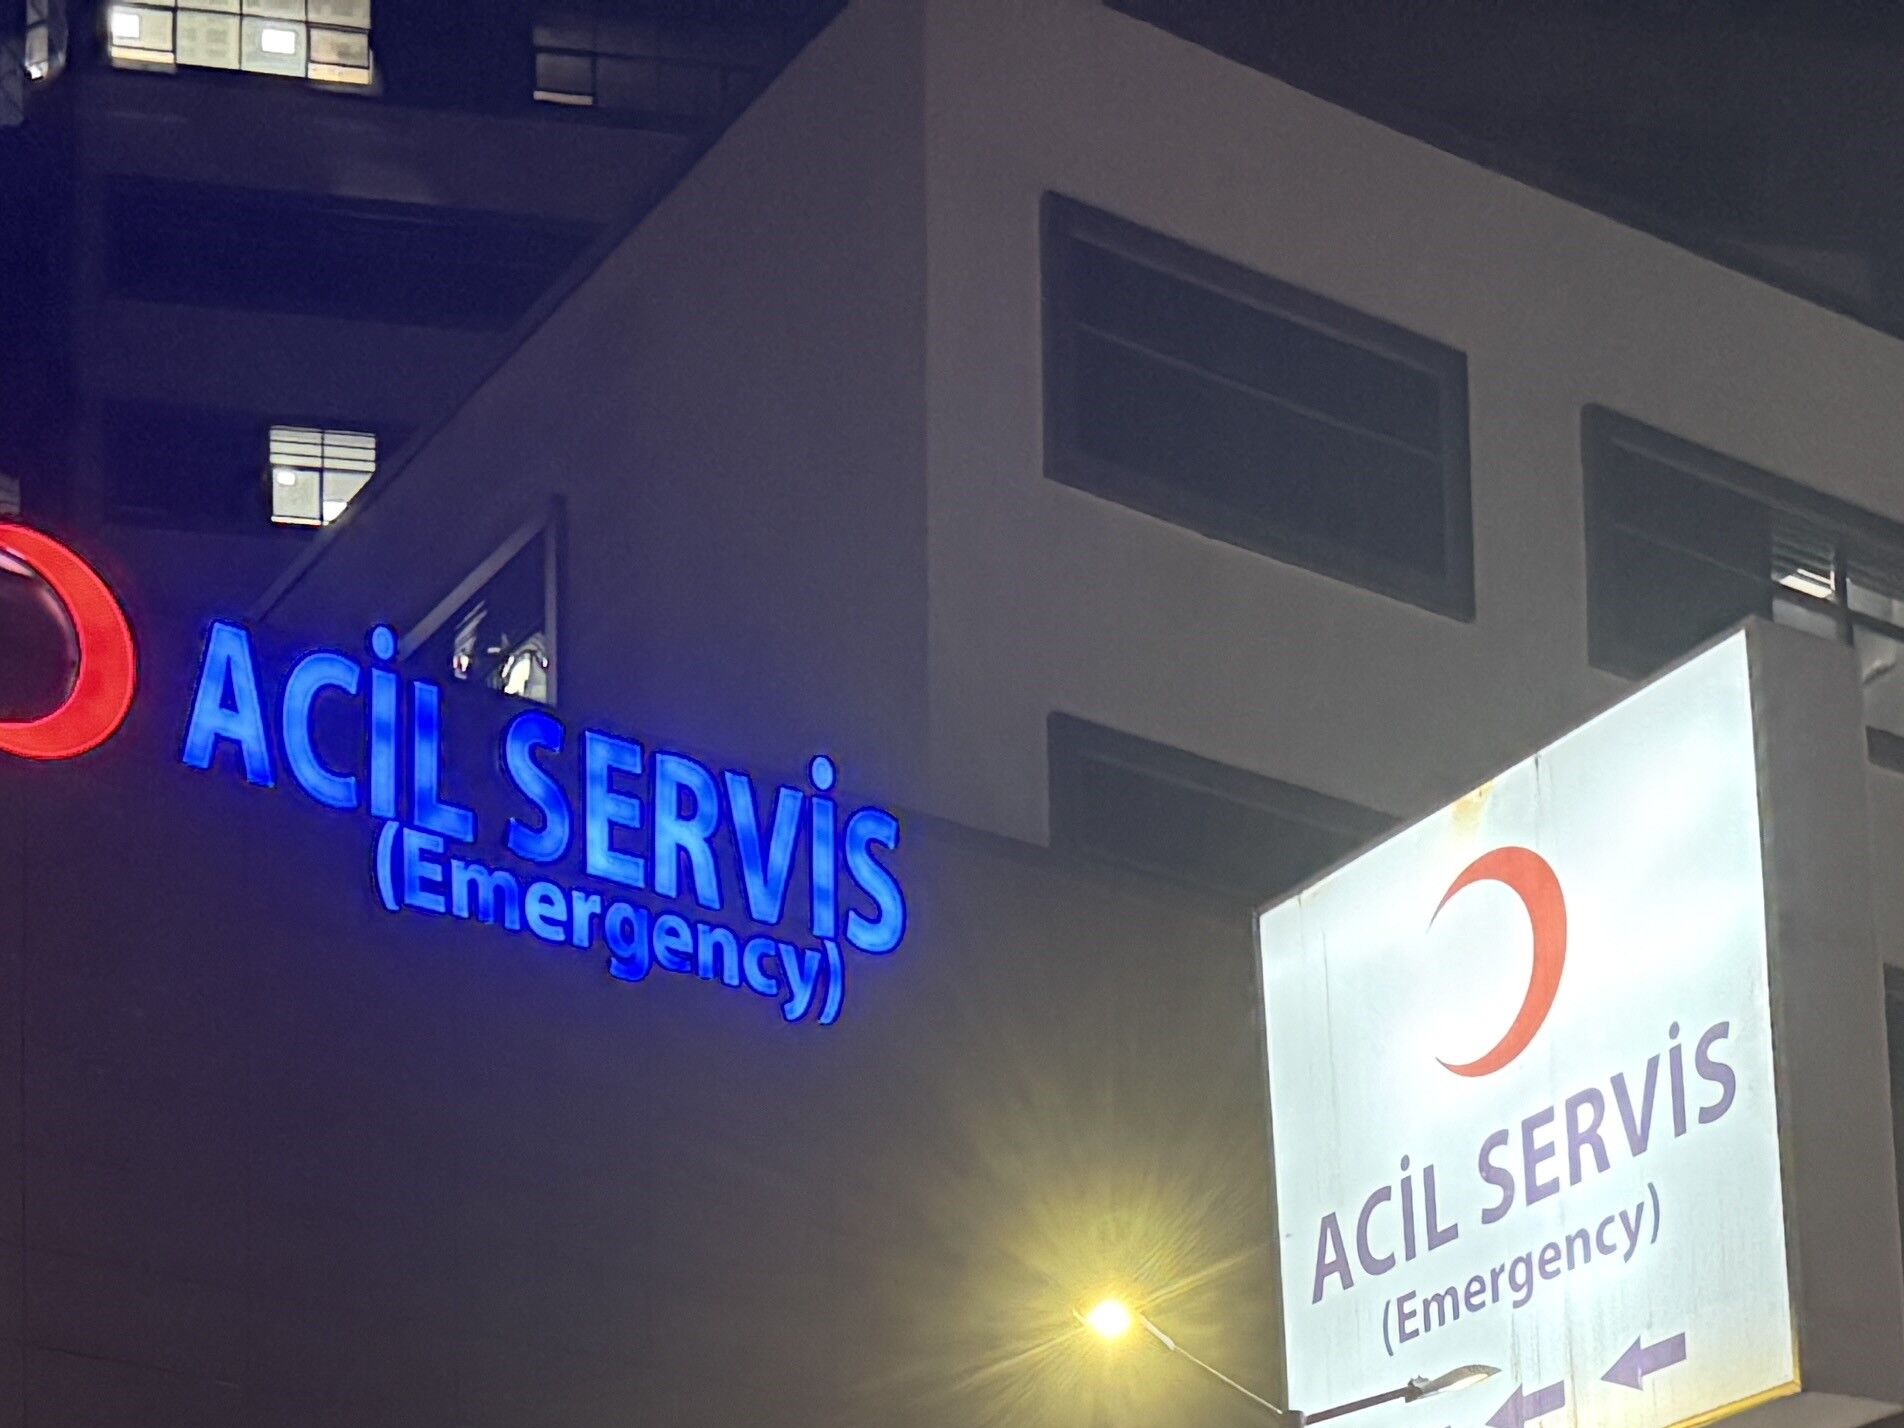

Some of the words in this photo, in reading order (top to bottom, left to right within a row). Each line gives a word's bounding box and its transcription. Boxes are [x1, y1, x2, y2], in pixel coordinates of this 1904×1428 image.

[182, 620, 477, 843] ACİL
[503, 710, 906, 954] SERVİS
[375, 820, 844, 1025] (Emergency)
[1310, 1154, 1458, 1304] ACİL
[1477, 1021, 1738, 1226] SERVİS
[1381, 1181, 1662, 1357] (Emergency)
